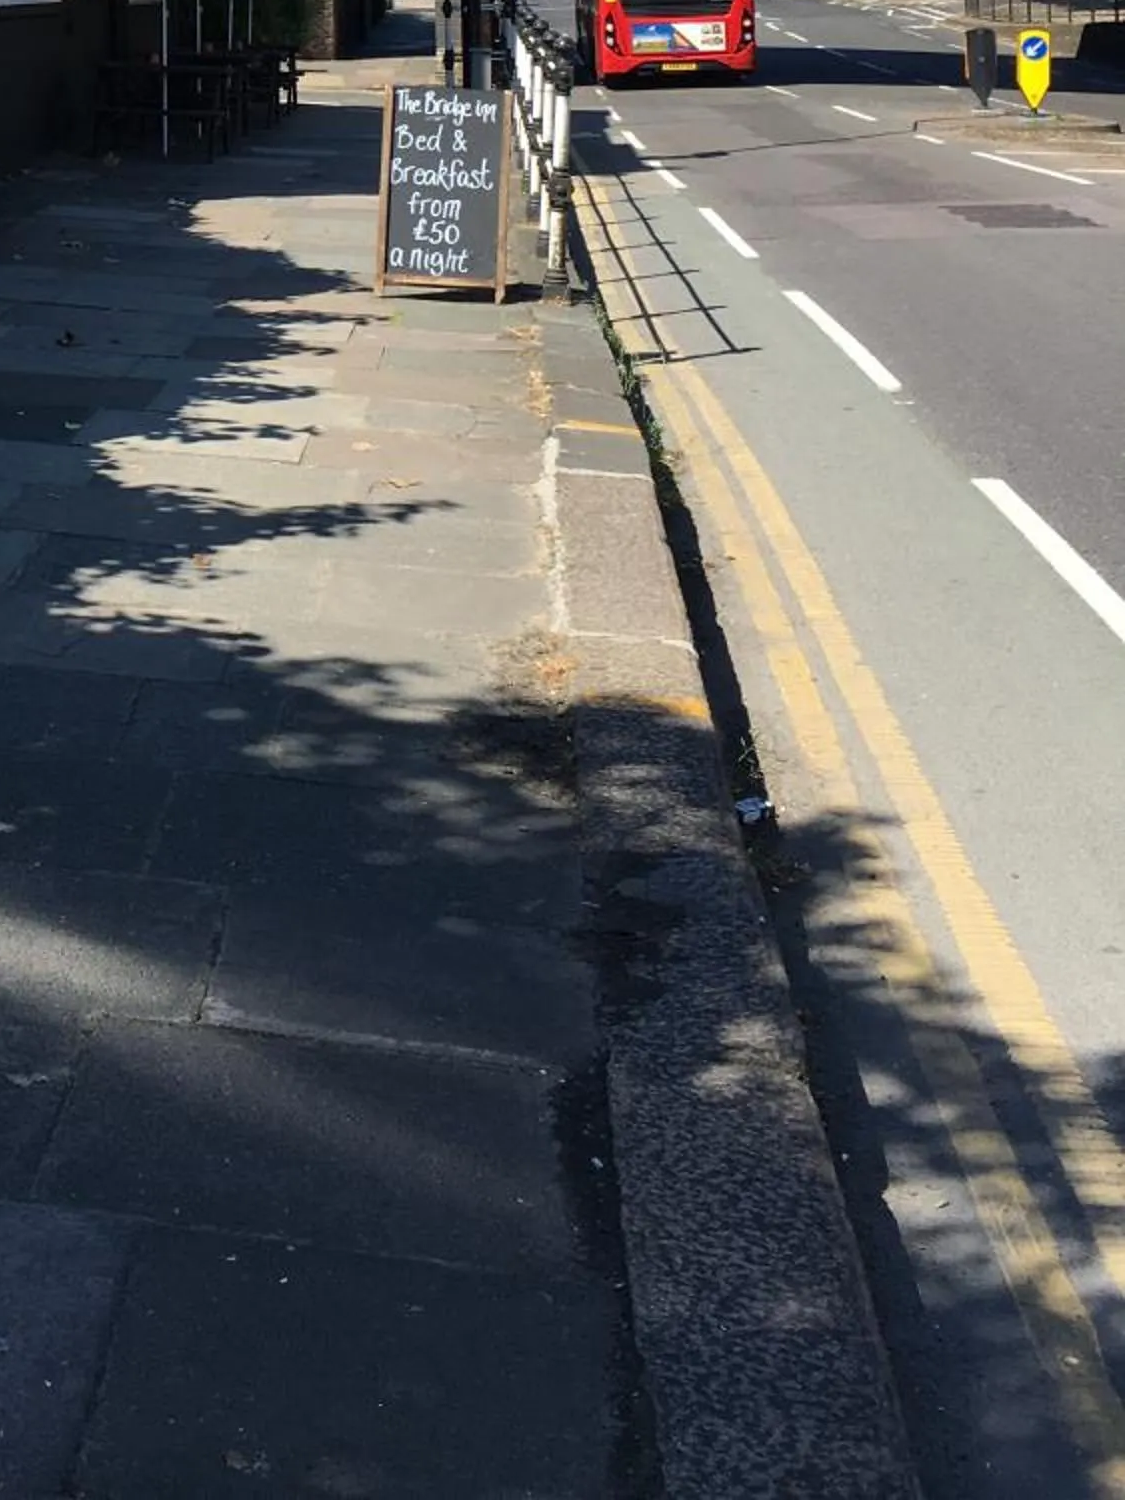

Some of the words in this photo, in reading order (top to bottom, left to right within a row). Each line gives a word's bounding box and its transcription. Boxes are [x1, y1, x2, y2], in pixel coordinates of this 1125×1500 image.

[396, 88, 422, 115] The
[425, 90, 472, 126] Bridge
[395, 124, 443, 152] Bed
[452, 129, 468, 152] &
[391, 157, 494, 191] Breakfast
[407, 191, 461, 220] from
[412, 218, 460, 245] £50
[390, 247, 403, 267] a
[409, 247, 469, 276] night
